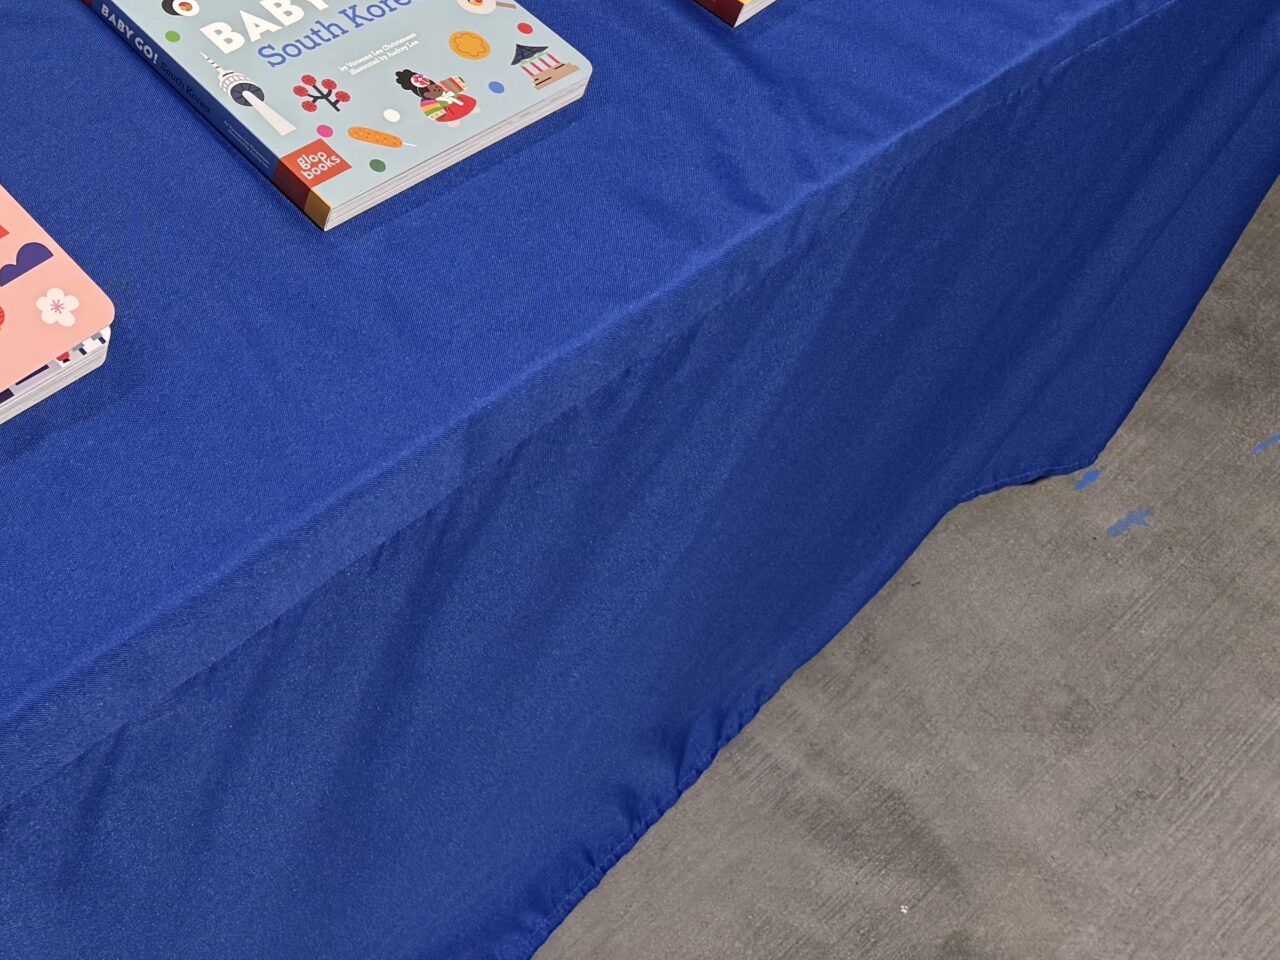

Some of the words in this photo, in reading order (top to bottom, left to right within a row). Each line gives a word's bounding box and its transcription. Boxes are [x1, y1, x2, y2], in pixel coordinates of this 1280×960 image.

[101, 4, 134, 42] BABY
[135, 37, 158, 64] GO!
[257, 13, 347, 69] South
[297, 151, 327, 170] glop
[301, 155, 340, 179] books
